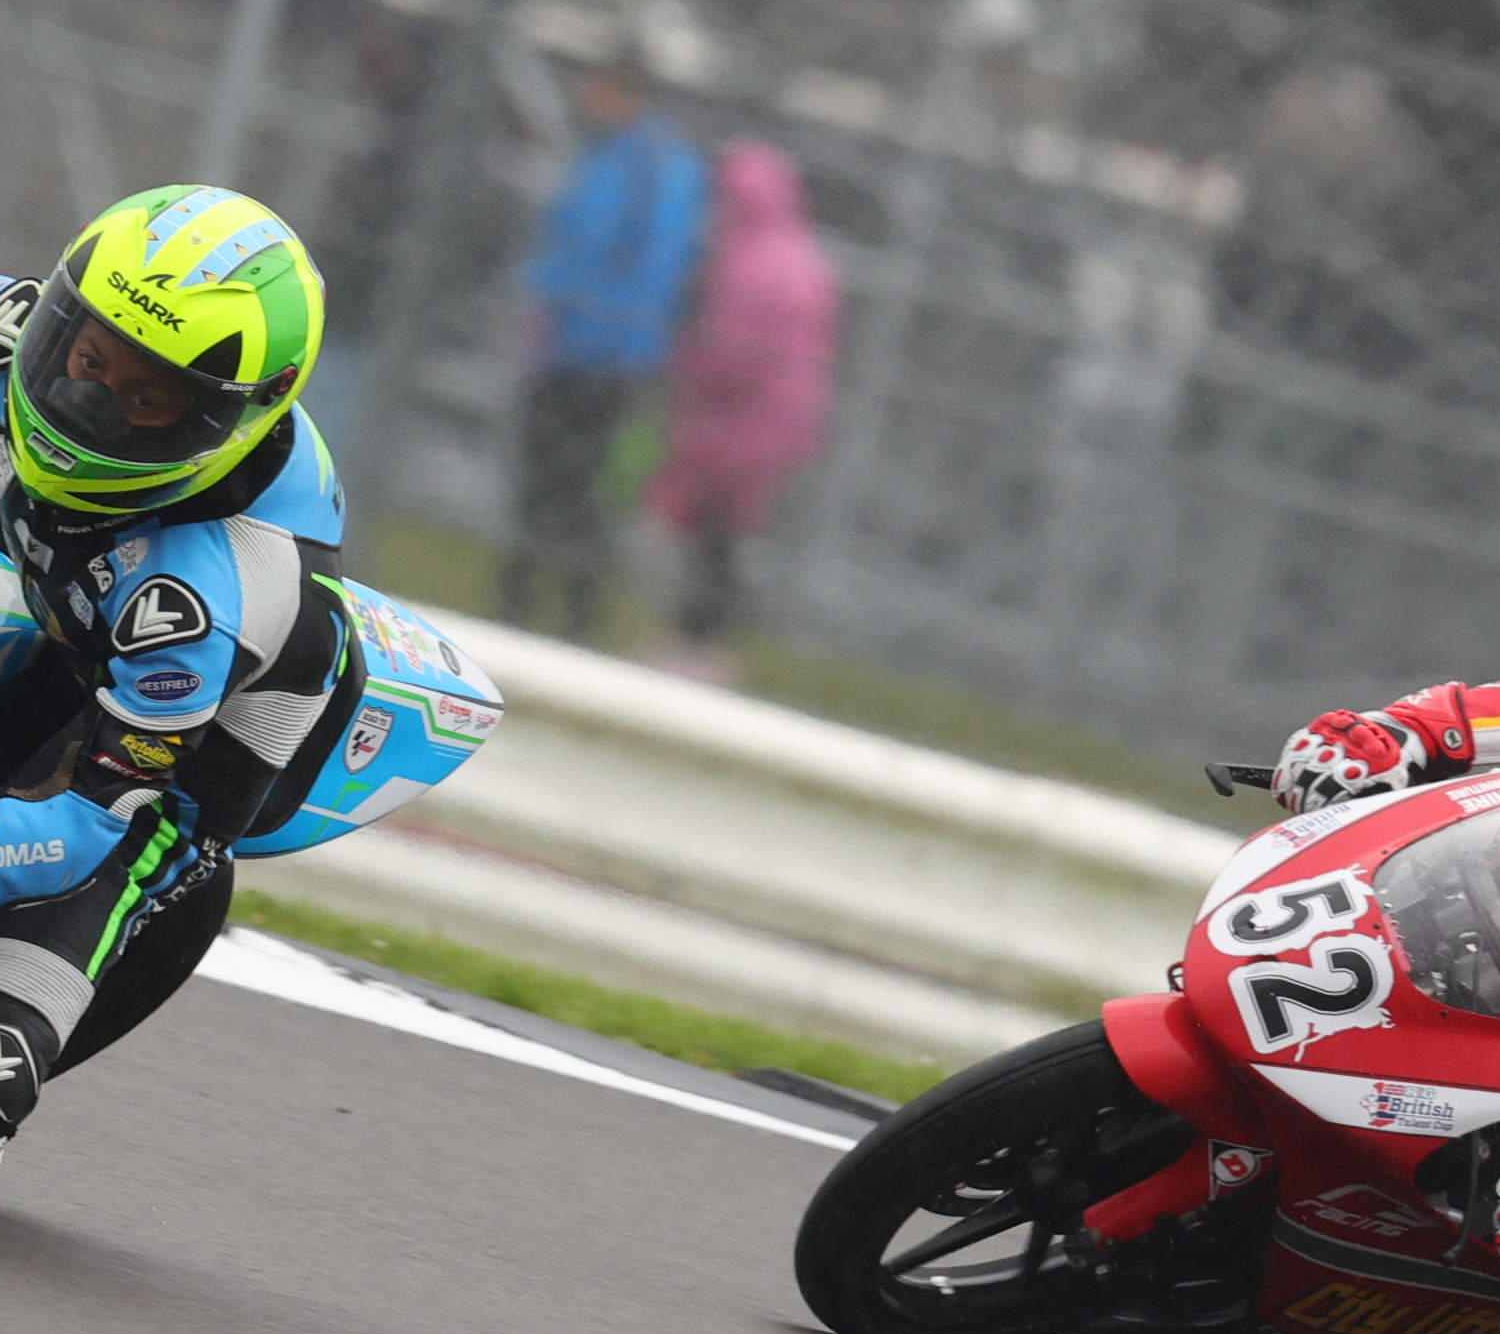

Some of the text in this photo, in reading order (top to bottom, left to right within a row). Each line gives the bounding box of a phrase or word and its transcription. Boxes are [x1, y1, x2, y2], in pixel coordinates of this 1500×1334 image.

[107, 270, 187, 333] SHARK
[220, 382, 256, 393] SHARK
[136, 677, 199, 692] WESTFIELD
[1229, 871, 1377, 1046] 52
[1389, 1097, 1454, 1118] British
[1292, 1197, 1412, 1240] racing
